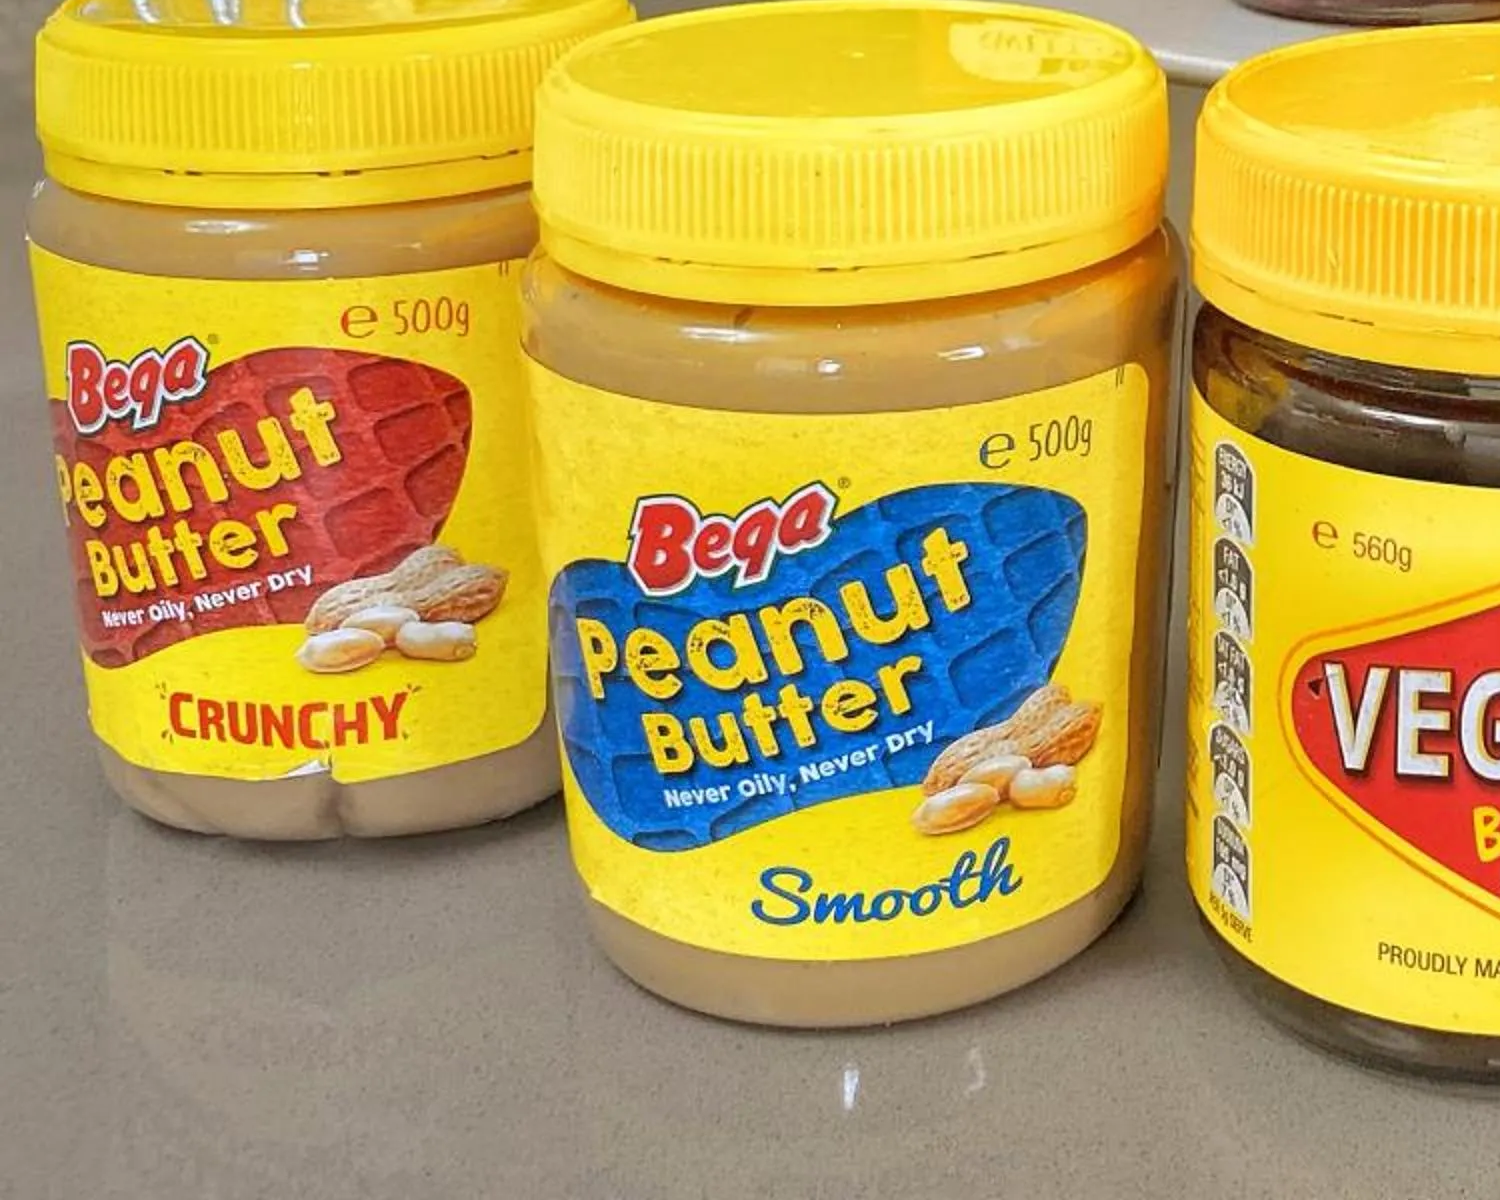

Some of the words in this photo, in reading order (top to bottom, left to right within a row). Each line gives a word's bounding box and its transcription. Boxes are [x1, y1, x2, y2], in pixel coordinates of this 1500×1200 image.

[393, 296, 470, 337] 500g
[68, 340, 204, 431] Bega
[1028, 415, 1093, 463] 500g
[86, 502, 299, 599] Butter
[629, 486, 834, 593] Bega
[1352, 531, 1414, 573] 560g
[102, 606, 145, 630] Never
[148, 597, 193, 625] Oily,
[195, 580, 263, 614] Never
[267, 564, 314, 596] Dry
[168, 690, 410, 750] CRUNCHY
[640, 650, 923, 777] Butter
[664, 783, 732, 810] Never
[738, 769, 798, 803] Oily,
[800, 743, 885, 784] Never
[887, 720, 936, 758] Dry
[750, 836, 1024, 927] Smooth
[1376, 941, 1468, 977] PROUDLY
